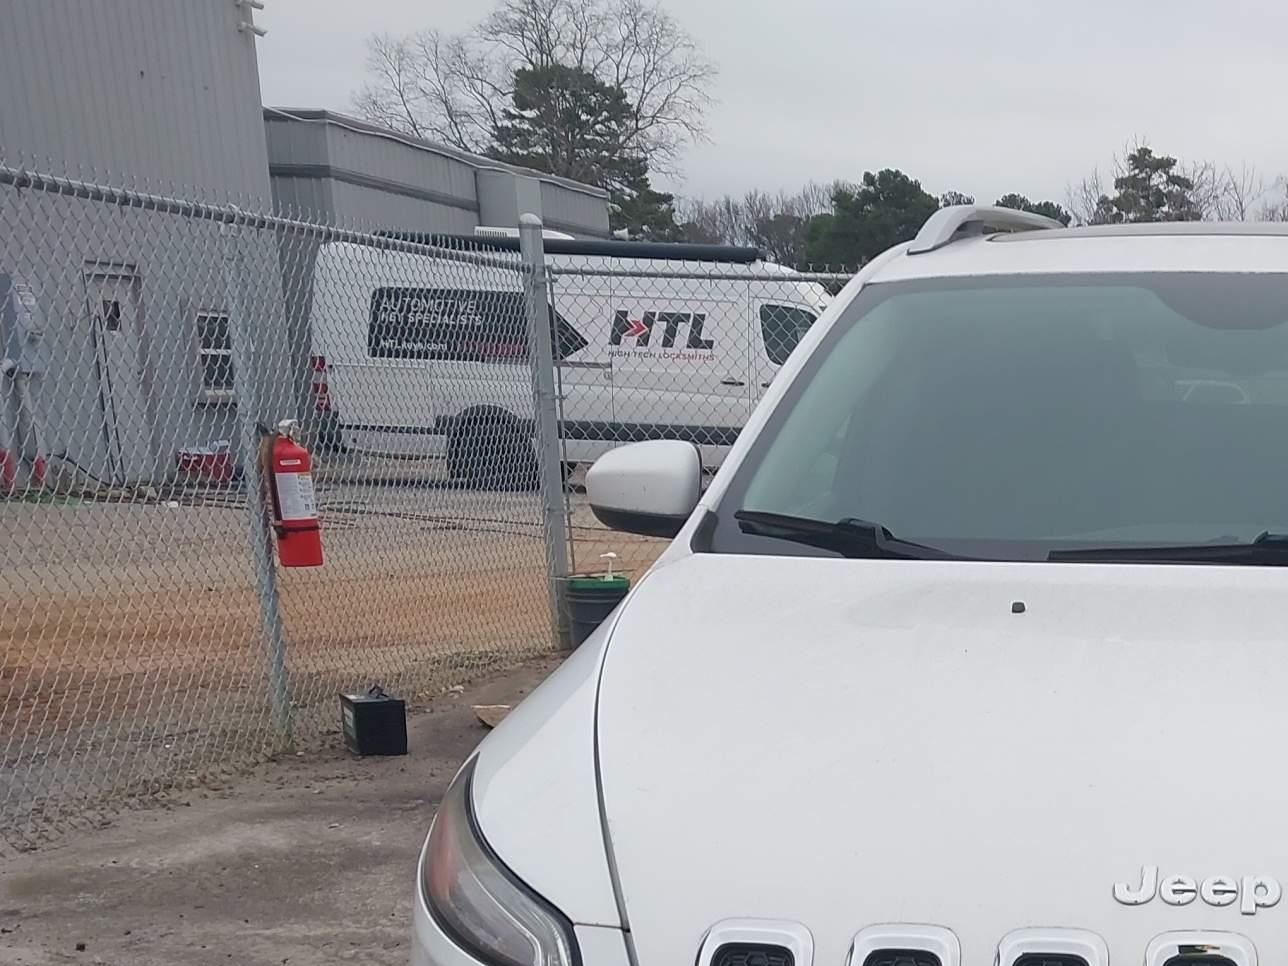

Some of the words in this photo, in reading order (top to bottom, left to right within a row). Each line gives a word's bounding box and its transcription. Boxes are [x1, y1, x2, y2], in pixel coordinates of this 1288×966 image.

[380, 298, 476, 314] AUTOMOTIVE
[407, 312, 482, 326] SPECIALISTS
[608, 350, 631, 358] HIGH
[658, 351, 715, 361] LOCKSMITHS
[1112, 864, 1282, 916] Jeep
